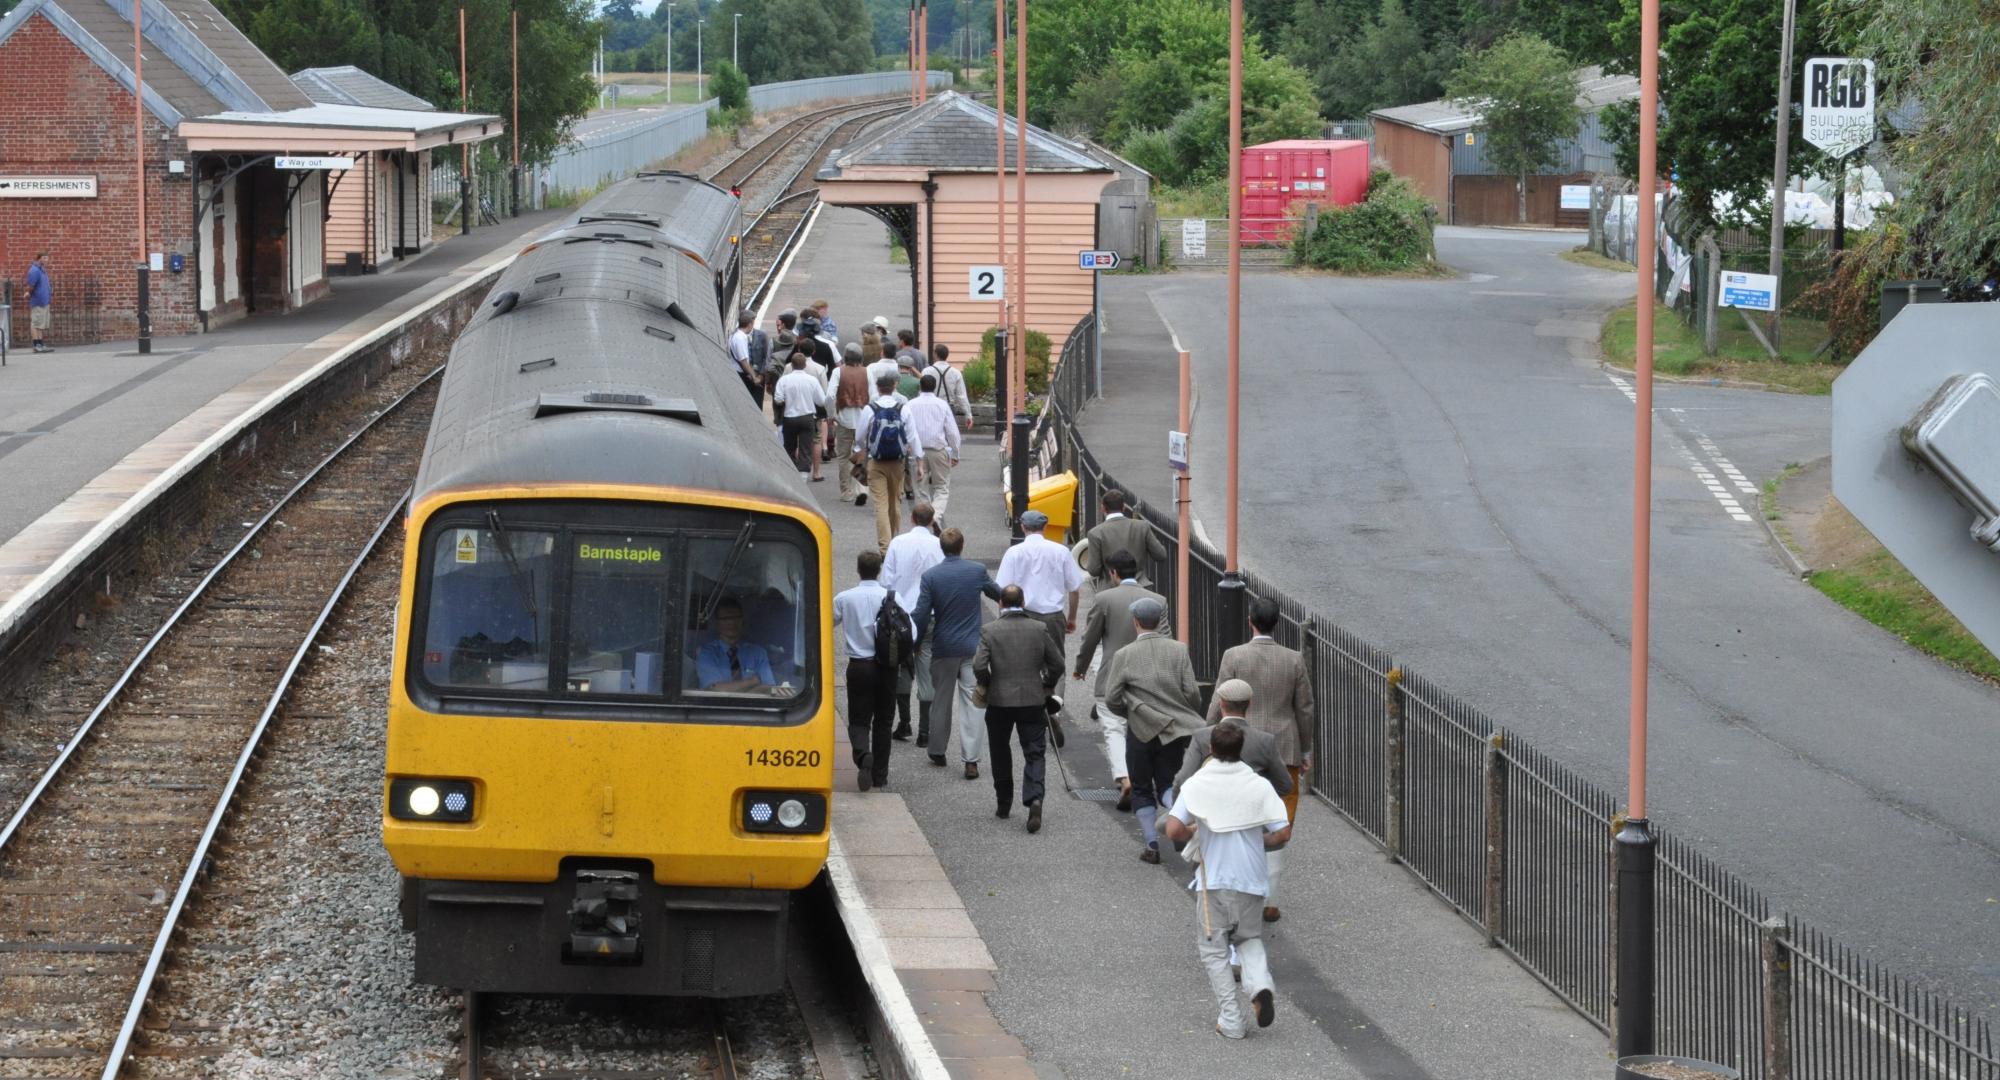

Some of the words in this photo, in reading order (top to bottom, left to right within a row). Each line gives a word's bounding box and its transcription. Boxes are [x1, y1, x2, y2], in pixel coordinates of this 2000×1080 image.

[1811, 64, 1867, 108] RGB
[1810, 115, 1866, 126] BUILDING
[978, 272, 995, 295] 2
[580, 544, 661, 563] Barnstaple
[745, 749, 820, 767] 143620
